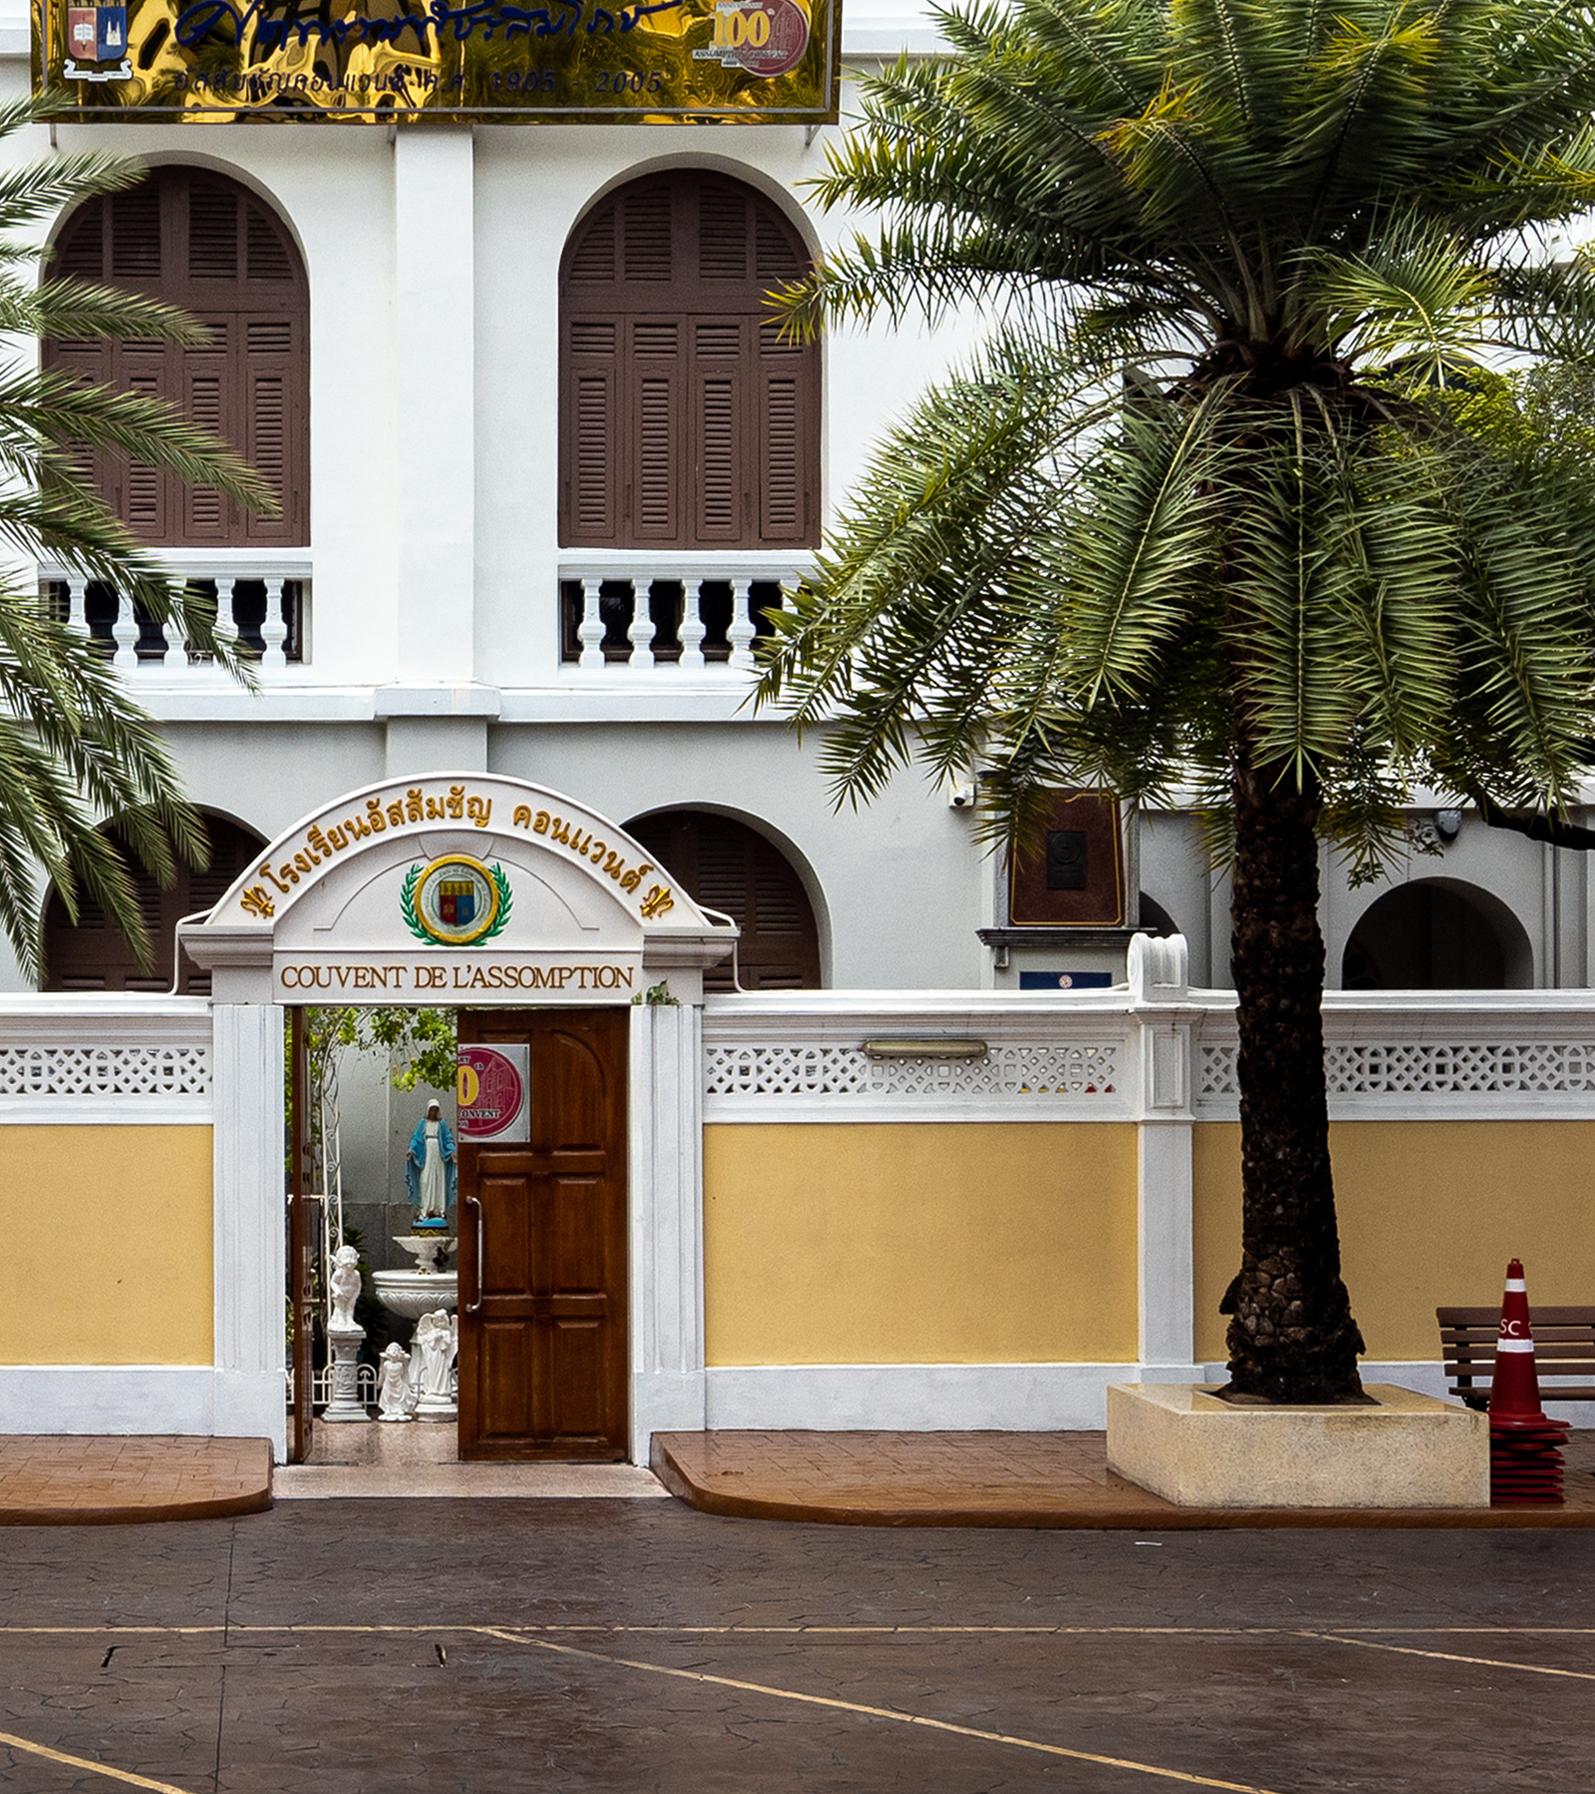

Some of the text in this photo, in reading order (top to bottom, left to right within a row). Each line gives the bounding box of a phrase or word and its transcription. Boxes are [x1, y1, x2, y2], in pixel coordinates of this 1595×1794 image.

[709, 10, 770, 47] 100
[493, 71, 556, 92] 1905
[594, 70, 662, 93] 2005
[259, 785, 654, 894] โรงเรียนอัสสัมชัญ คอนแวนต์
[280, 964, 635, 989] COUVENT DE L'ASSOMPTION
